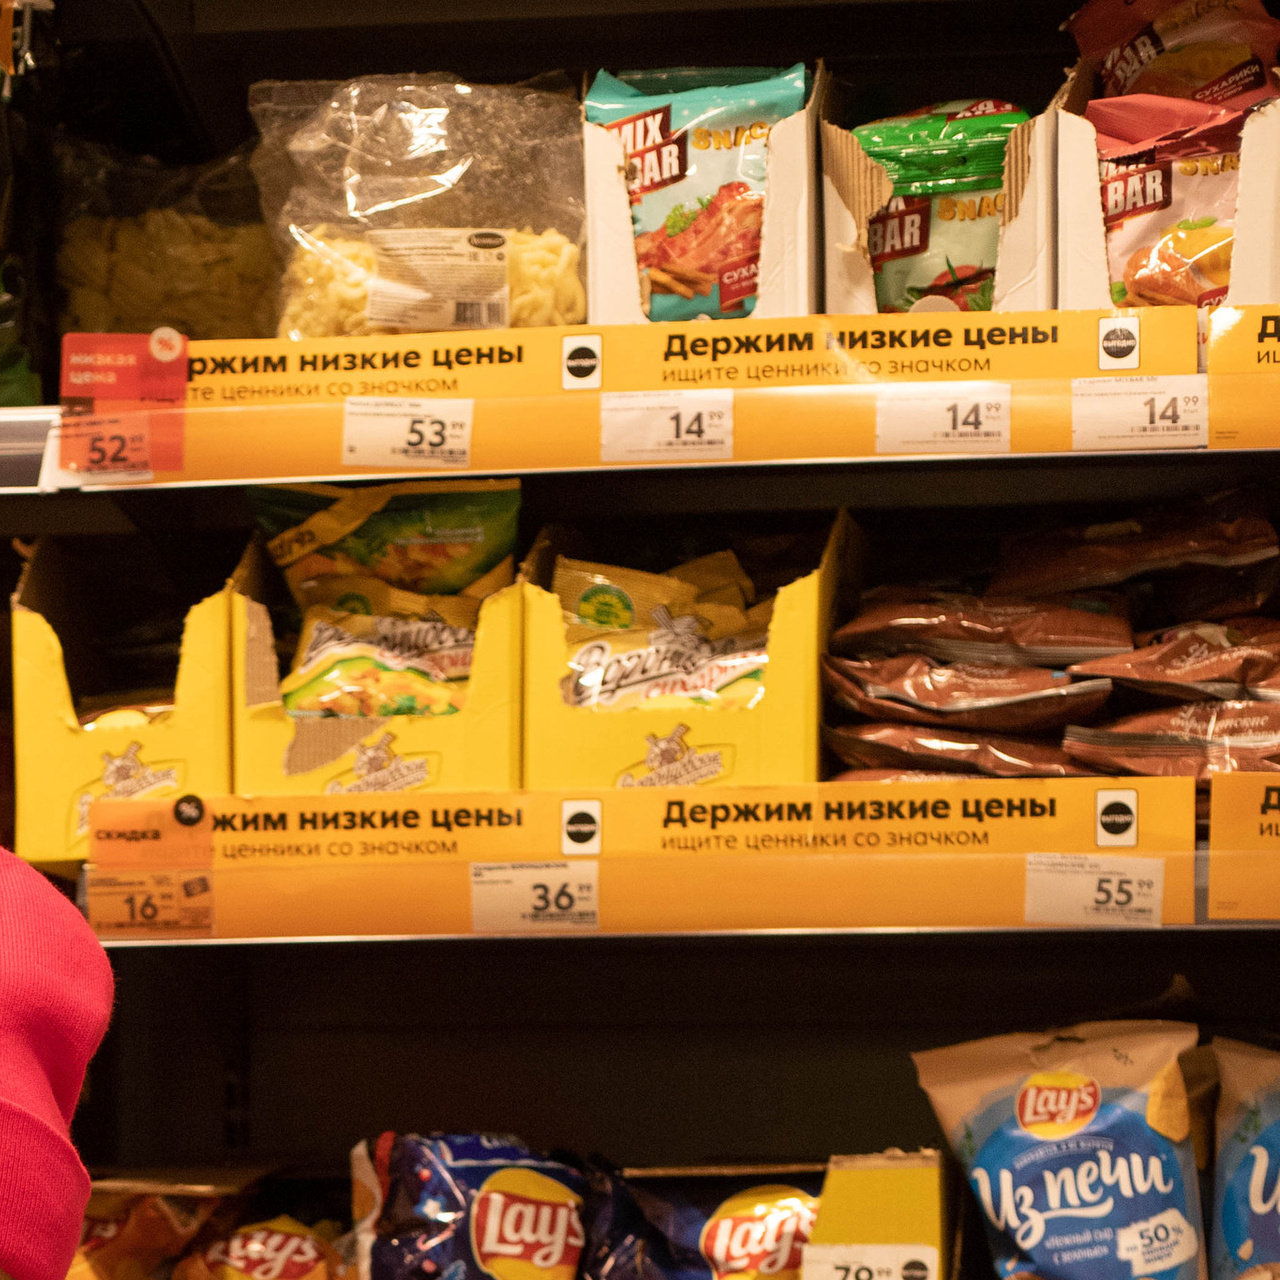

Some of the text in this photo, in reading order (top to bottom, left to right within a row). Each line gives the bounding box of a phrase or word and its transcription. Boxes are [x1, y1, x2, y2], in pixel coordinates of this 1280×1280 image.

[619, 113, 663, 153] MIX
[1107, 168, 1165, 218] BAR
[869, 212, 921, 257] BAR
[663, 325, 1058, 361] Держим низкие цены
[300, 350, 421, 372] низкие
[433, 345, 524, 369] цены
[662, 367, 739, 383] ищите
[746, 362, 848, 381] ценники
[888, 357, 991, 374] значком
[222, 382, 320, 400] ценники
[327, 381, 353, 395] со
[359, 378, 458, 394] значком
[946, 402, 1002, 431] 14 99
[1143, 395, 1199, 425] 14 99
[406, 419, 446, 447] 53
[670, 411, 705, 439] 14
[89, 435, 127, 464] 52
[300, 808, 420, 830] низкие
[431, 807, 523, 831] цены
[663, 797, 1056, 829] Держим низкие цены
[222, 840, 458, 860] ценники со значком
[662, 830, 990, 852] ищите ценники со значком
[532, 882, 575, 911] 36
[1094, 878, 1133, 905] 55
[124, 894, 159, 921] 16
[1024, 1084, 1095, 1125] Lay's
[972, 1167, 1046, 1250] Из
[1043, 1150, 1174, 1210] печи
[1139, 1223, 1170, 1247] 50
